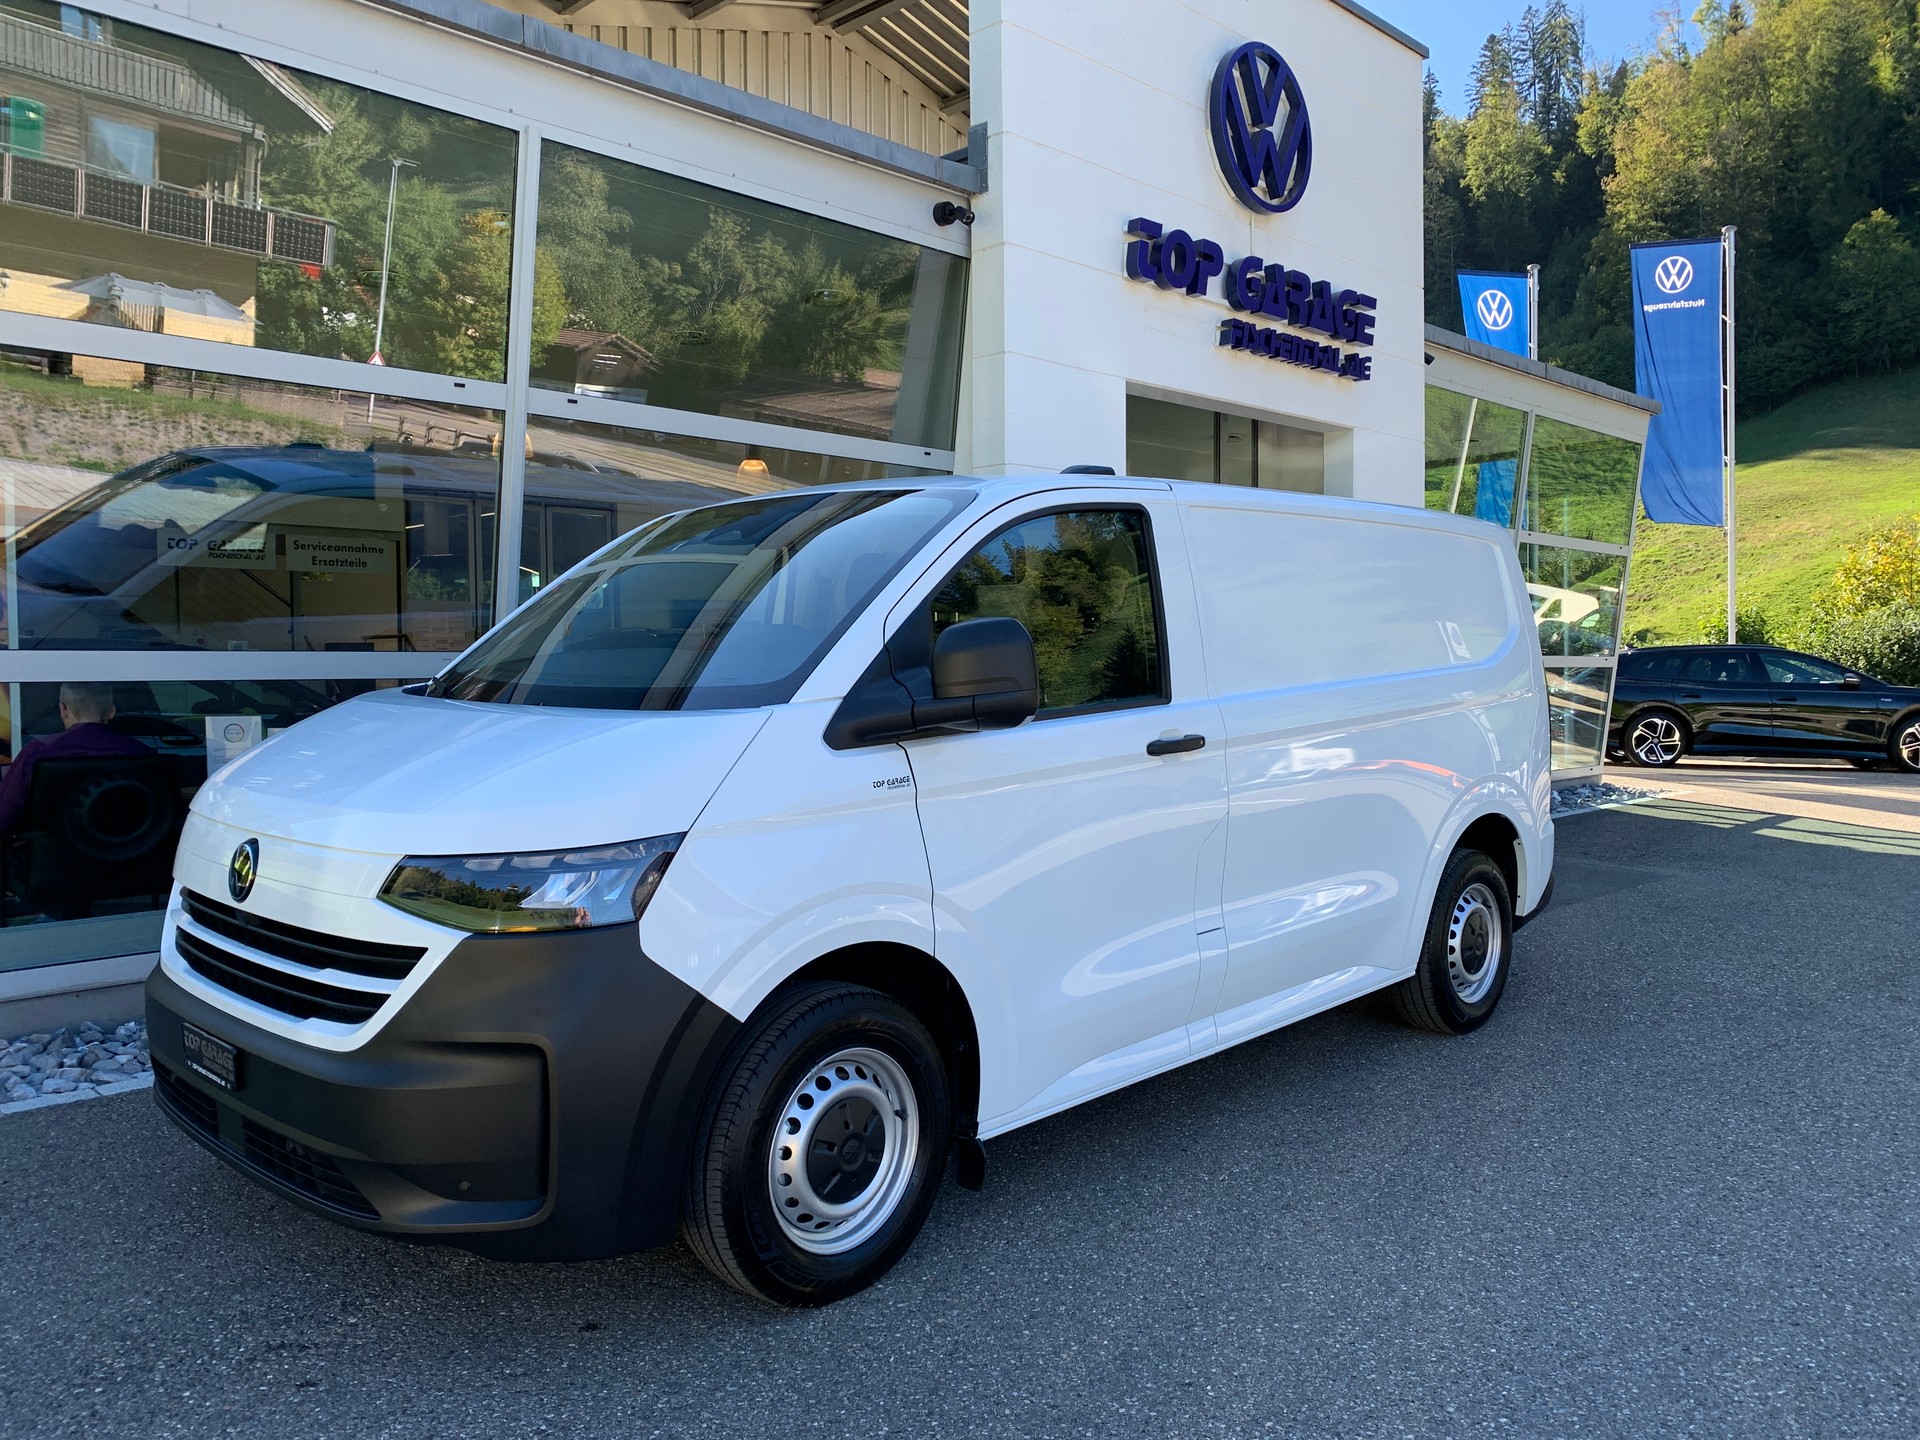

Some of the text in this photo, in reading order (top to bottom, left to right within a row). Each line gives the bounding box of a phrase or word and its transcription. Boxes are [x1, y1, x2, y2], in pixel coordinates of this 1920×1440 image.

[1212, 42, 1312, 214] VW
[1126, 217, 1377, 347] TOP GARAGE
[1655, 256, 1693, 294] VW
[1478, 290, 1513, 330] VW
[1219, 318, 1372, 382] FISCHENTHAL AG
[167, 537, 266, 553] TOP GAGE
[293, 540, 384, 554] Serviceannahme
[311, 555, 368, 568] Ersatzteile
[872, 780, 885, 788] TOP
[886, 775, 910, 785] GARAGE
[184, 1030, 200, 1051] TOP
[201, 1040, 234, 1071] GARAGE
